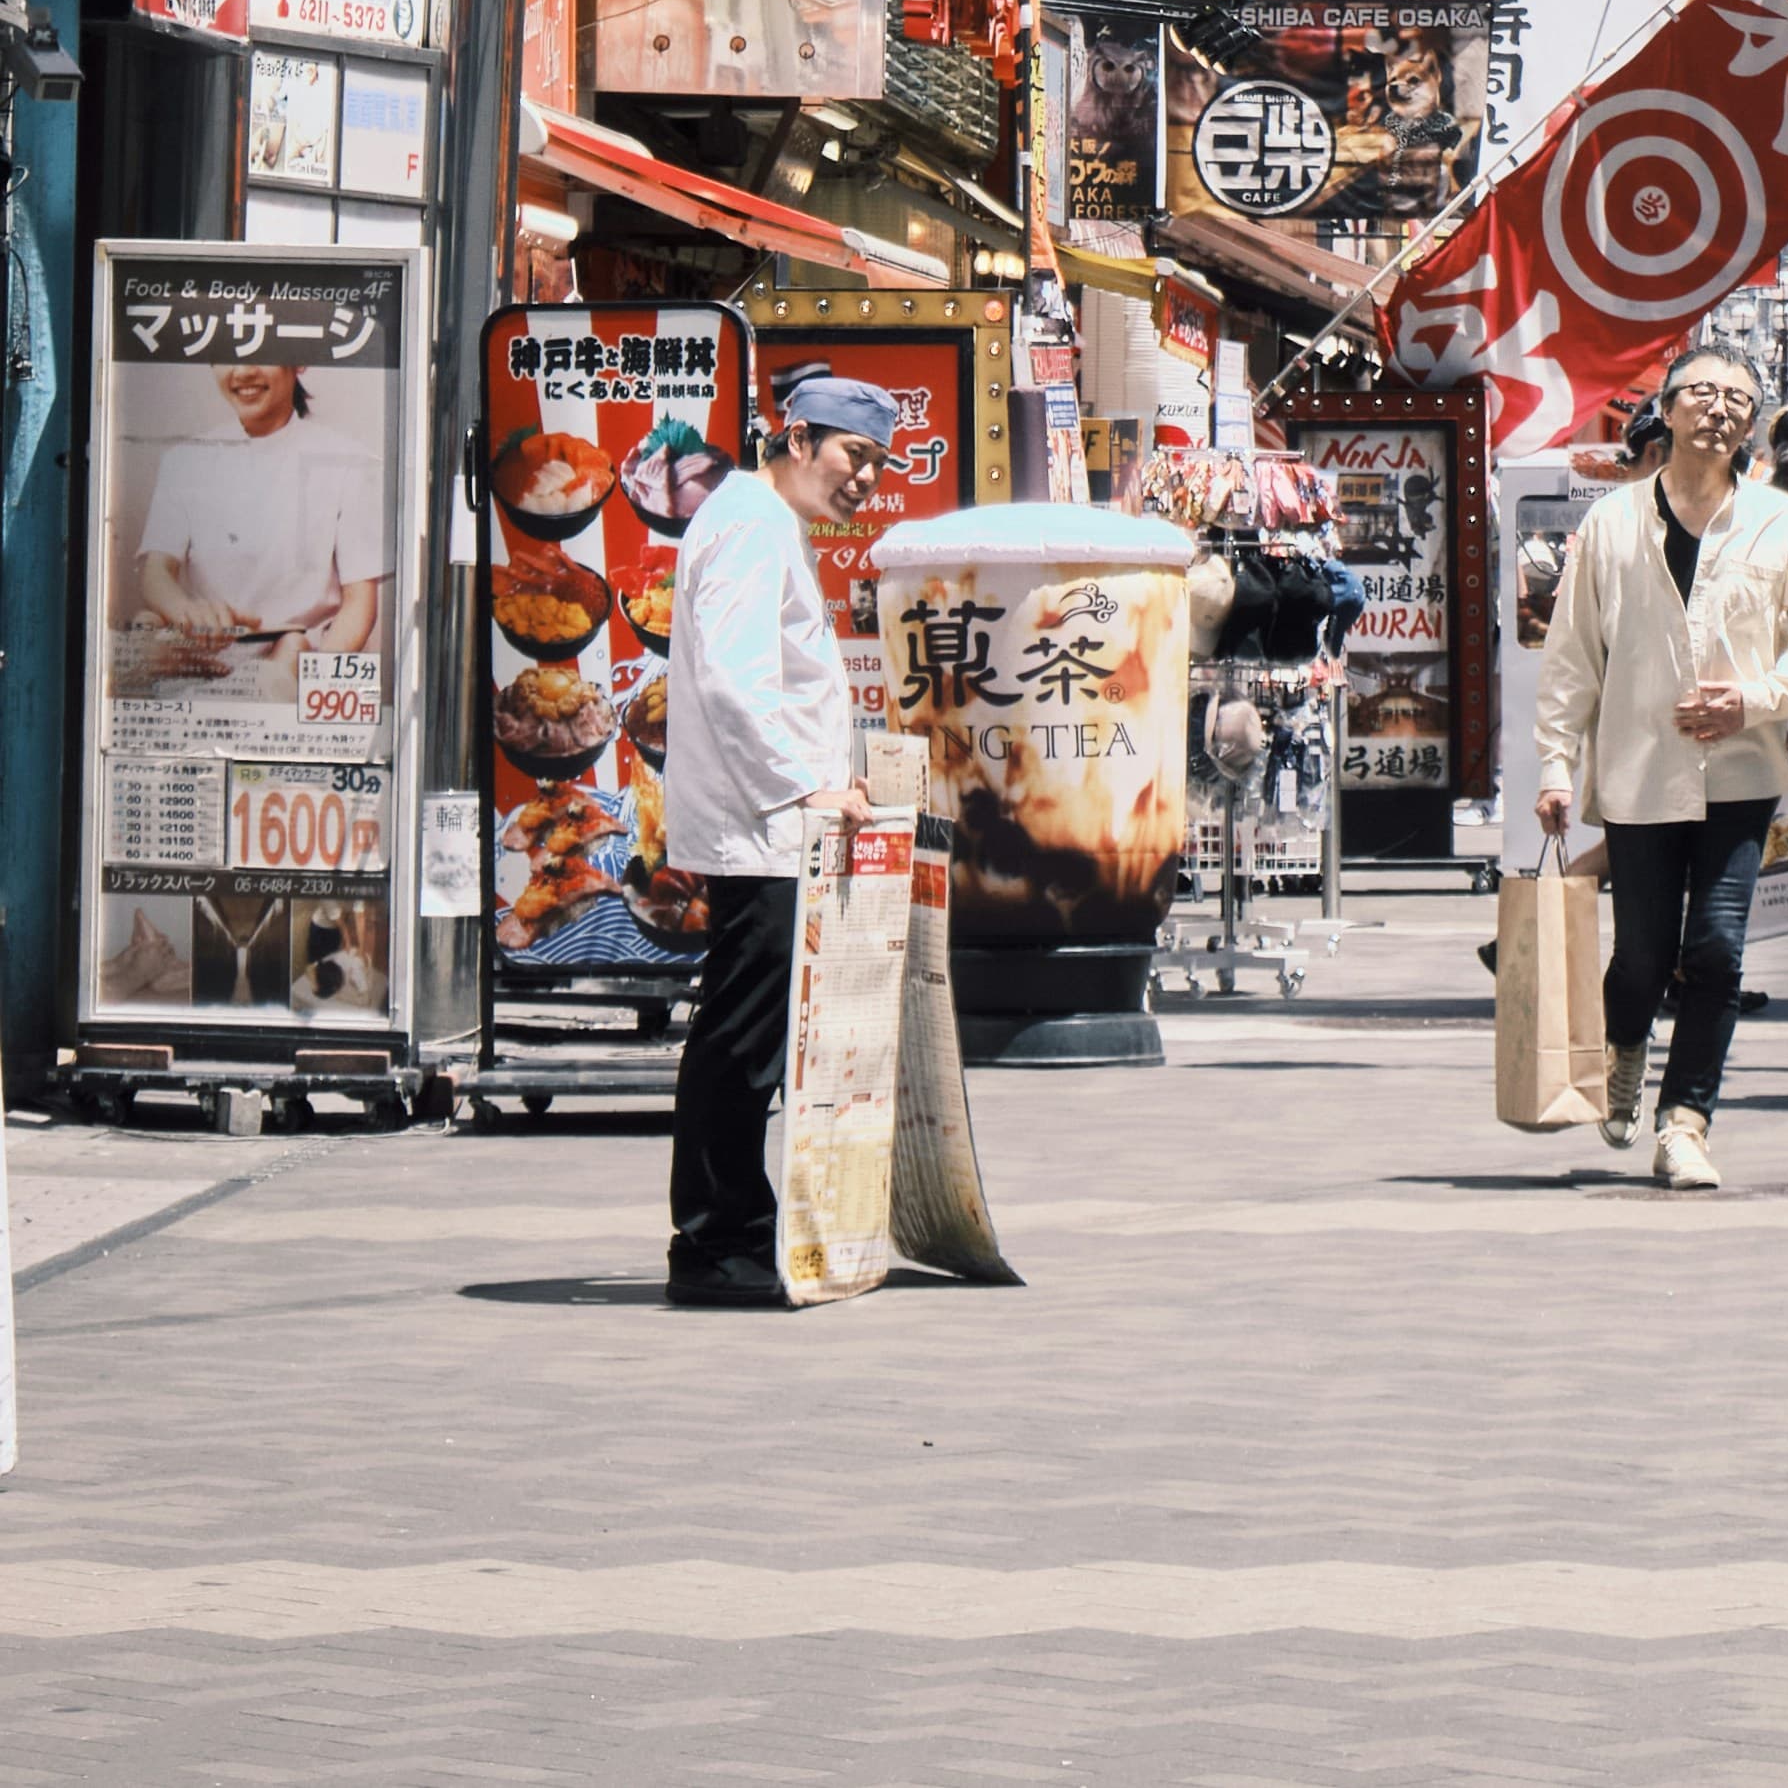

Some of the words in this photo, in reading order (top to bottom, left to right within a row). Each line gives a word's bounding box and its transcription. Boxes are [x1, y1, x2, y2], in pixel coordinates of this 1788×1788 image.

[1323, 7, 1390, 28] CAFE
[1399, 7, 1484, 28] OSAKA
[1241, 191, 1282, 204] CAFE
[123, 277, 173, 298] Foot
[180, 279, 199, 299] &
[207, 280, 262, 304] Body
[269, 281, 361, 307] Massage
[362, 280, 393, 300] 4F
[125, 302, 378, 360] マッサージ
[510, 336, 717, 377] 神戸牛と海鮮丼
[545, 381, 652, 400] にくあんど
[656, 383, 716, 399] 道頓堀店
[1318, 434, 1428, 471] NINJA
[329, 653, 376, 681] 15分
[304, 689, 376, 722] 990円
[1033, 722, 1138, 759] TEA
[1342, 746, 1444, 781] 弓道場
[331, 765, 382, 794] 30分
[232, 790, 381, 866] 1600円
[110, 873, 216, 891] リラックスパーク
